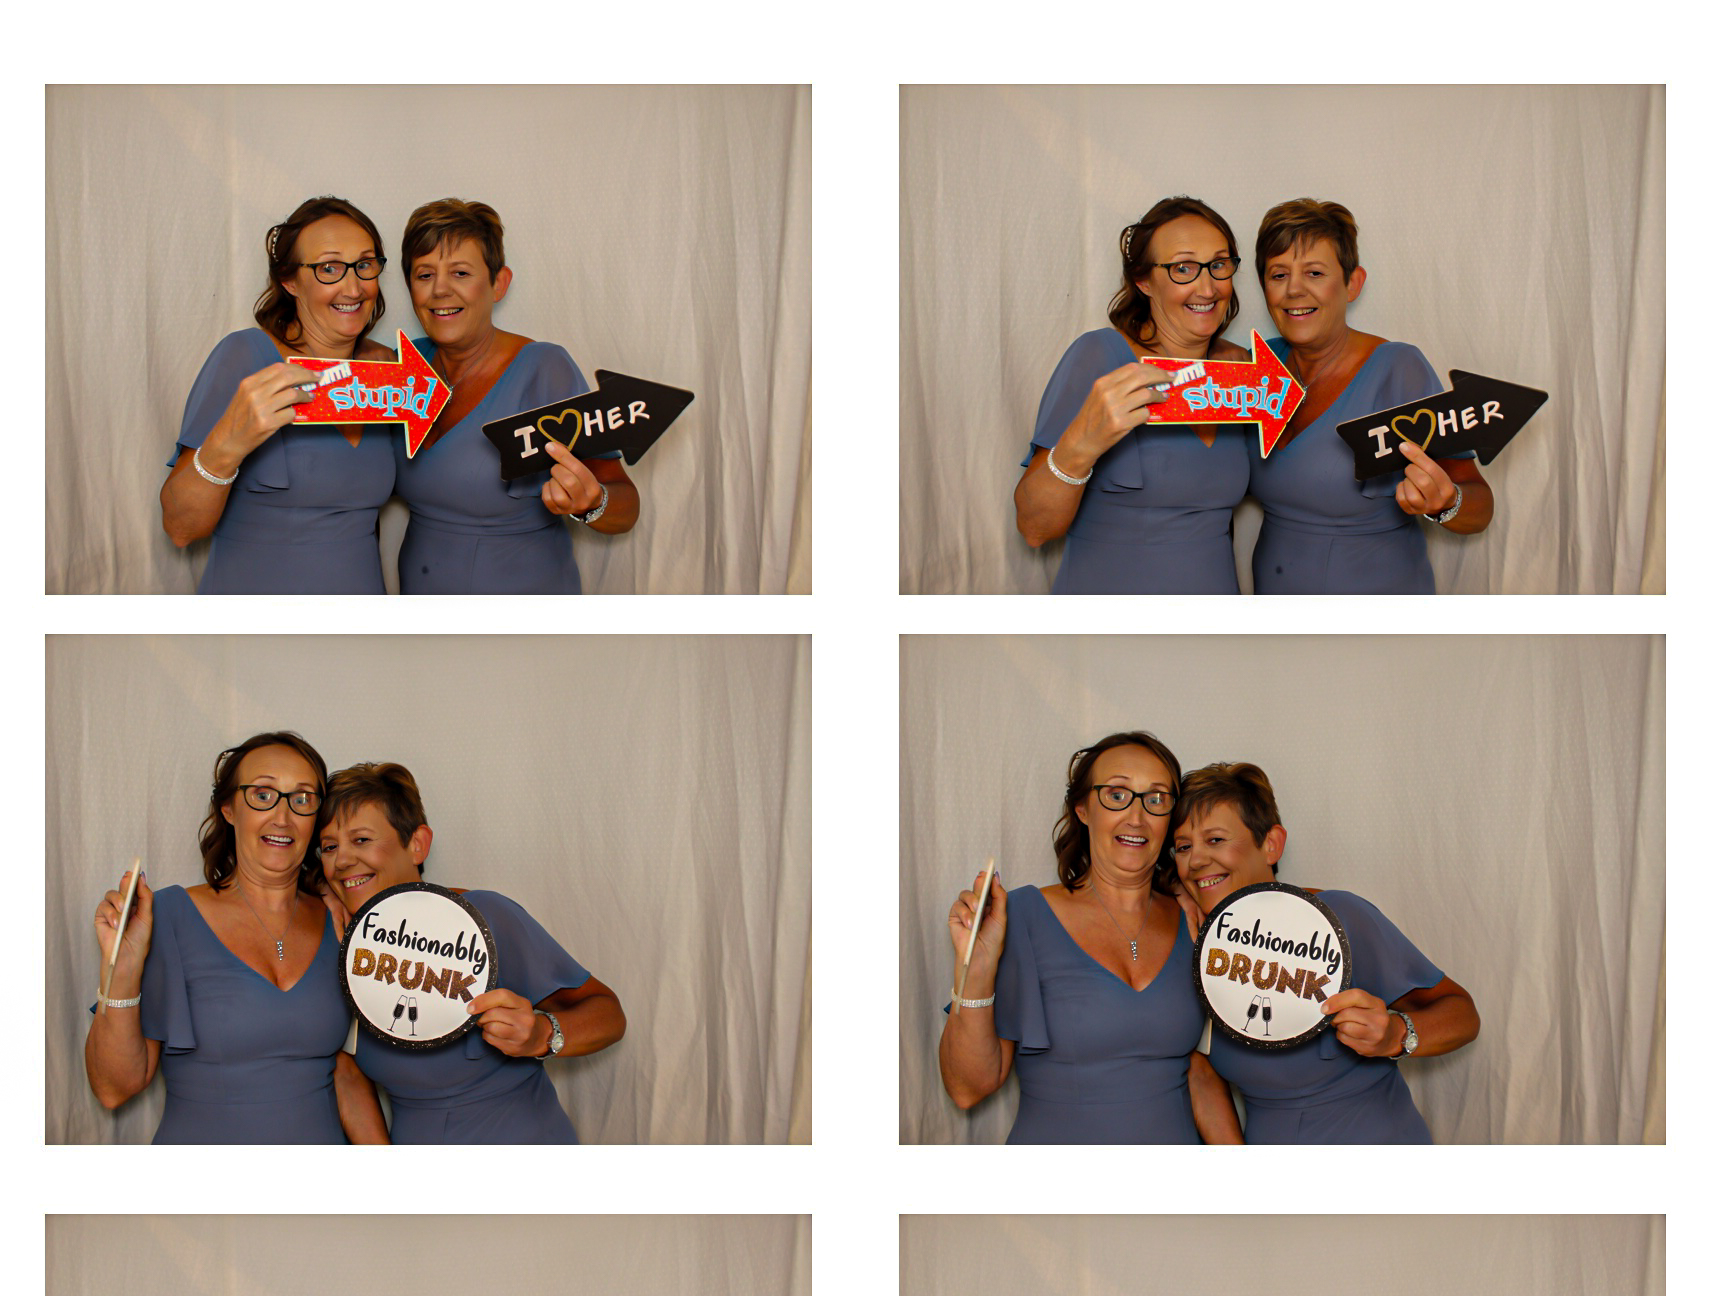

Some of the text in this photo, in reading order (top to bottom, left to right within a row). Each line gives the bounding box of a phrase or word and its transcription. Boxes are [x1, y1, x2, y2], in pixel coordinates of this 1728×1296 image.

[328, 376, 438, 419] stupid
[1182, 376, 1292, 419] stupid
[514, 400, 650, 459] I HER
[1368, 400, 1504, 459] I HER
[362, 911, 487, 976] Fashionably
[1216, 911, 1341, 976] Fashionably
[351, 948, 477, 1004] DRUNK
[1205, 948, 1331, 1004] DRUNK
